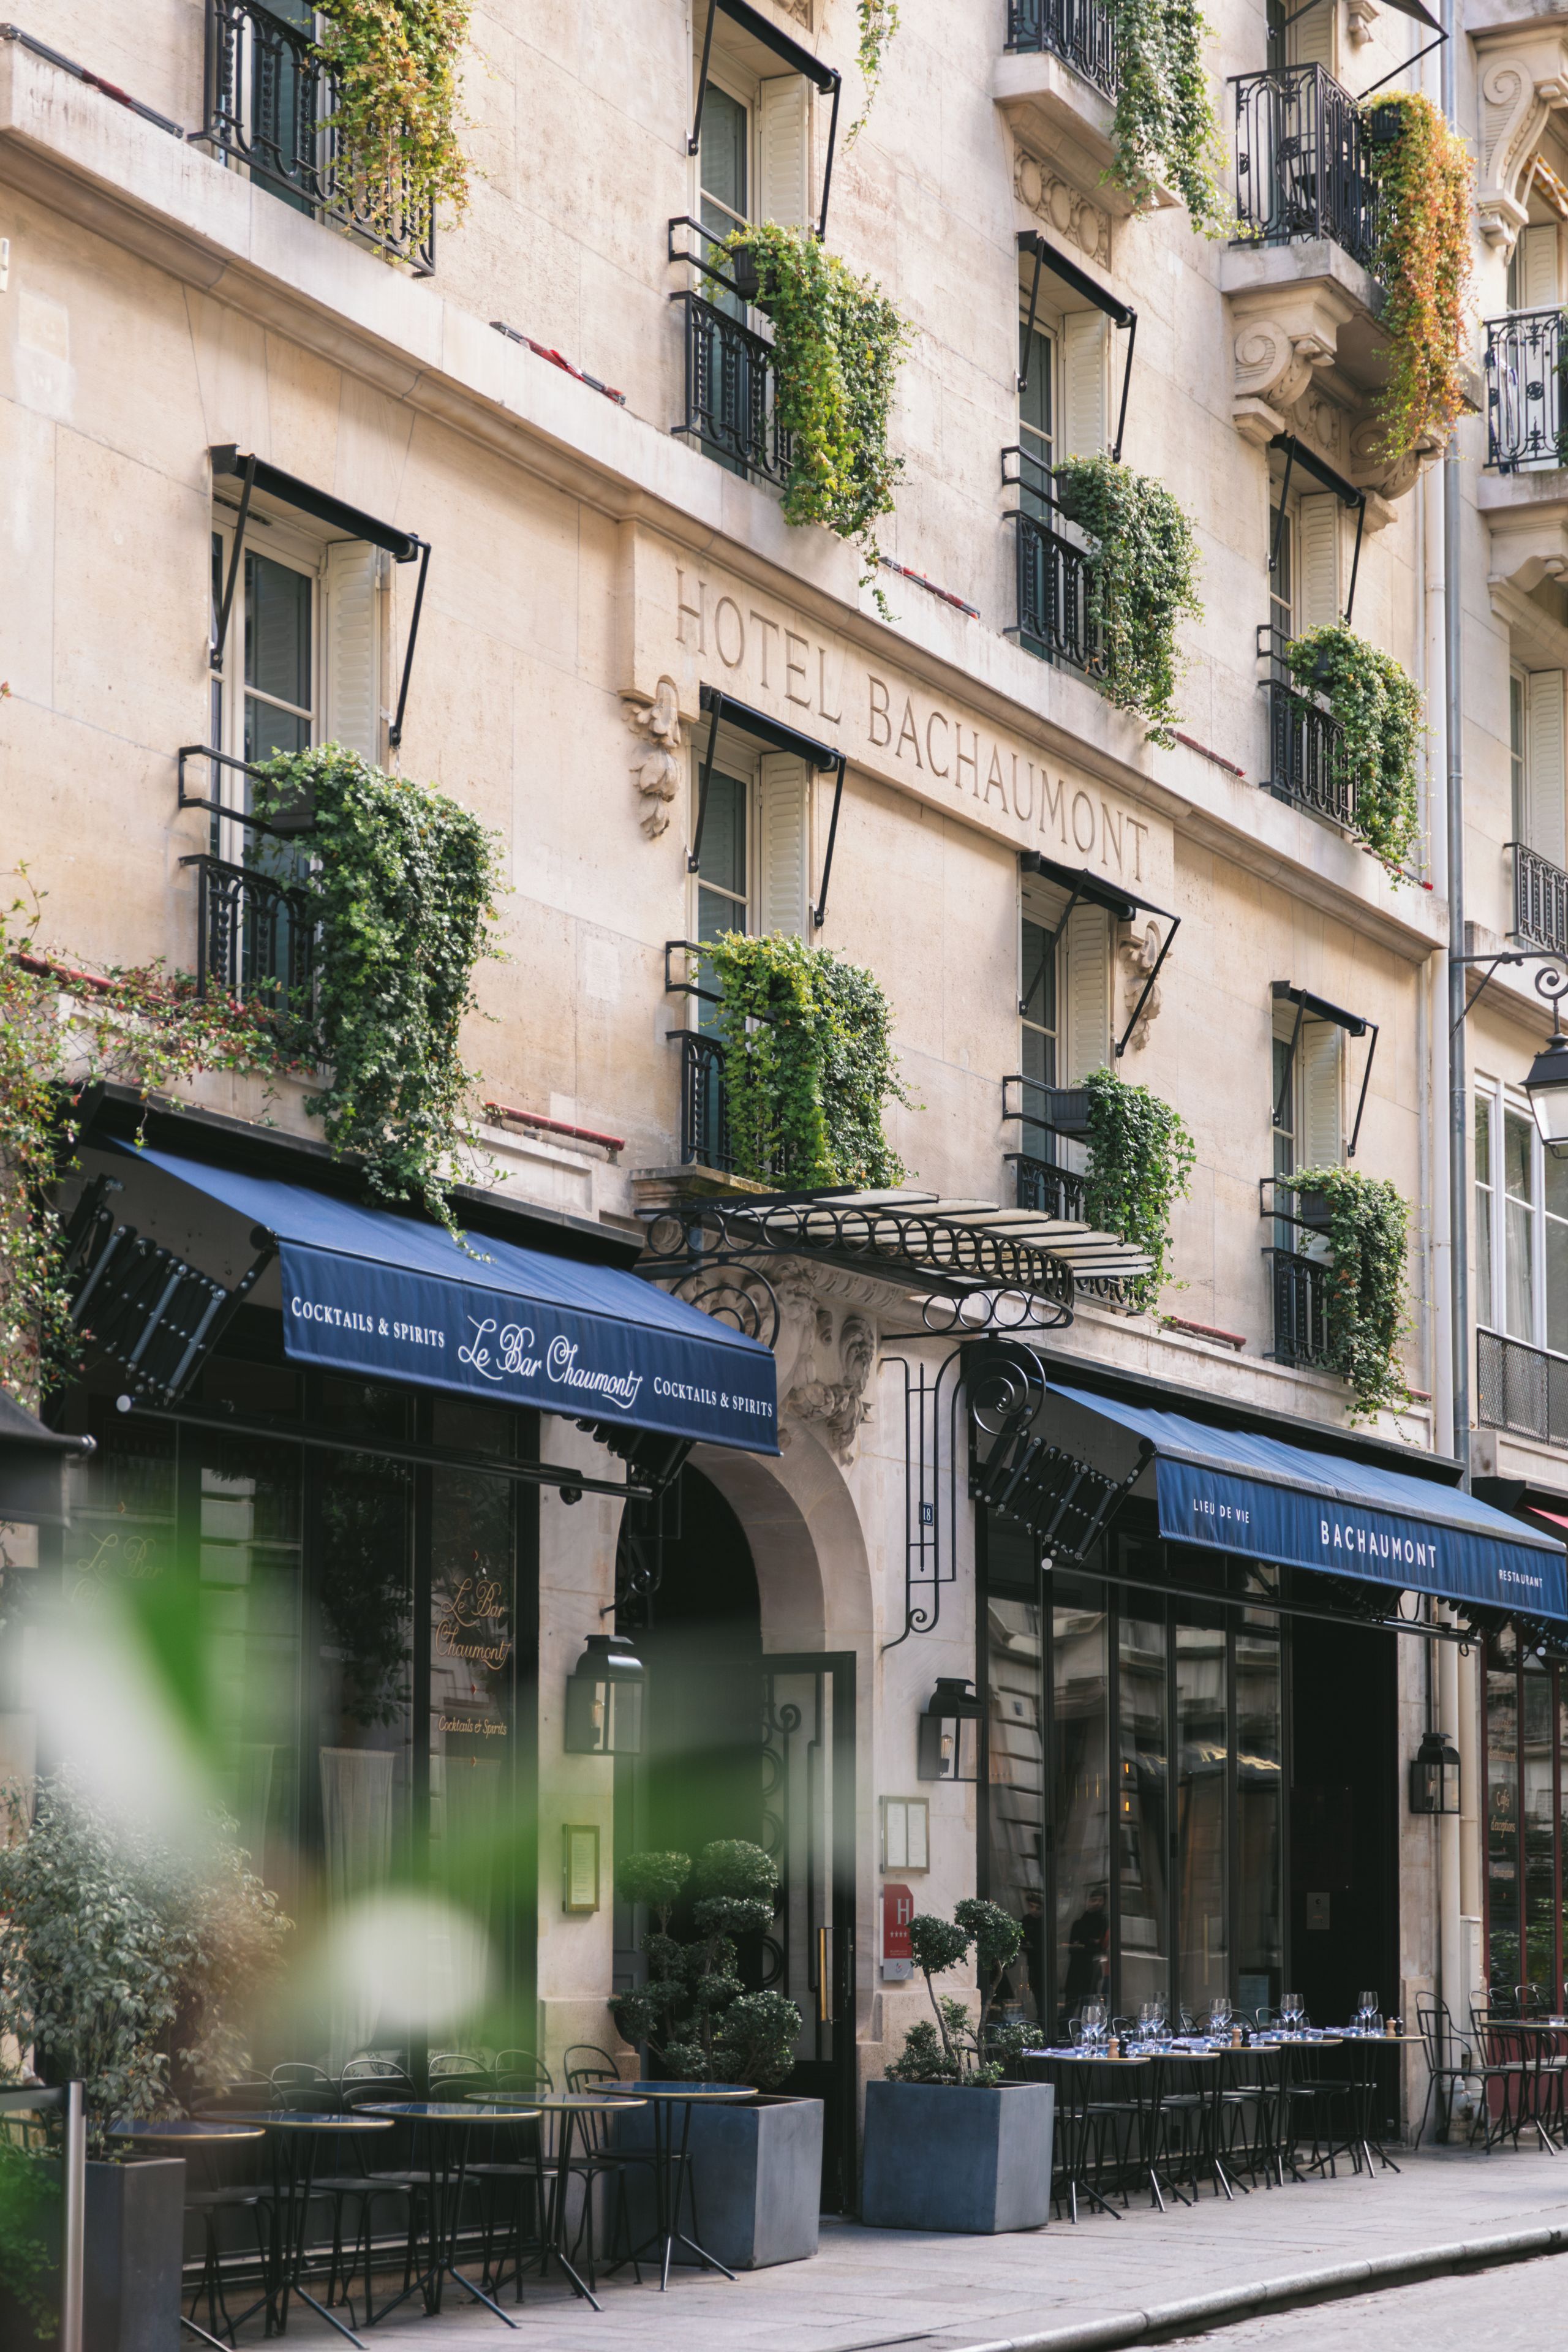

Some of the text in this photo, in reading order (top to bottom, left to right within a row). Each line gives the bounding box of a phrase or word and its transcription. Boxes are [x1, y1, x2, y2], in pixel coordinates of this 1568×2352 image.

[676, 567, 1149, 883] HOTEL BACHAUMONT
[292, 1296, 445, 1348] COCKTAILS & SPIRITS
[458, 1315, 643, 1409] Le Bar Chaumont
[654, 1376, 772, 1417] COCKTAILS & SPIRITS
[1193, 1499, 1250, 1523] LIEU DE VIE
[1321, 1520, 1436, 1568] BACHAUMONT
[441, 1578, 505, 1627] Le Bar
[1499, 1569, 1543, 1588] RESTAURANT
[435, 1619, 511, 1670] Chaumont
[439, 1715, 473, 1733] Cocktails
[482, 1718, 507, 1740] Spirits
[897, 1898, 910, 1925] H
